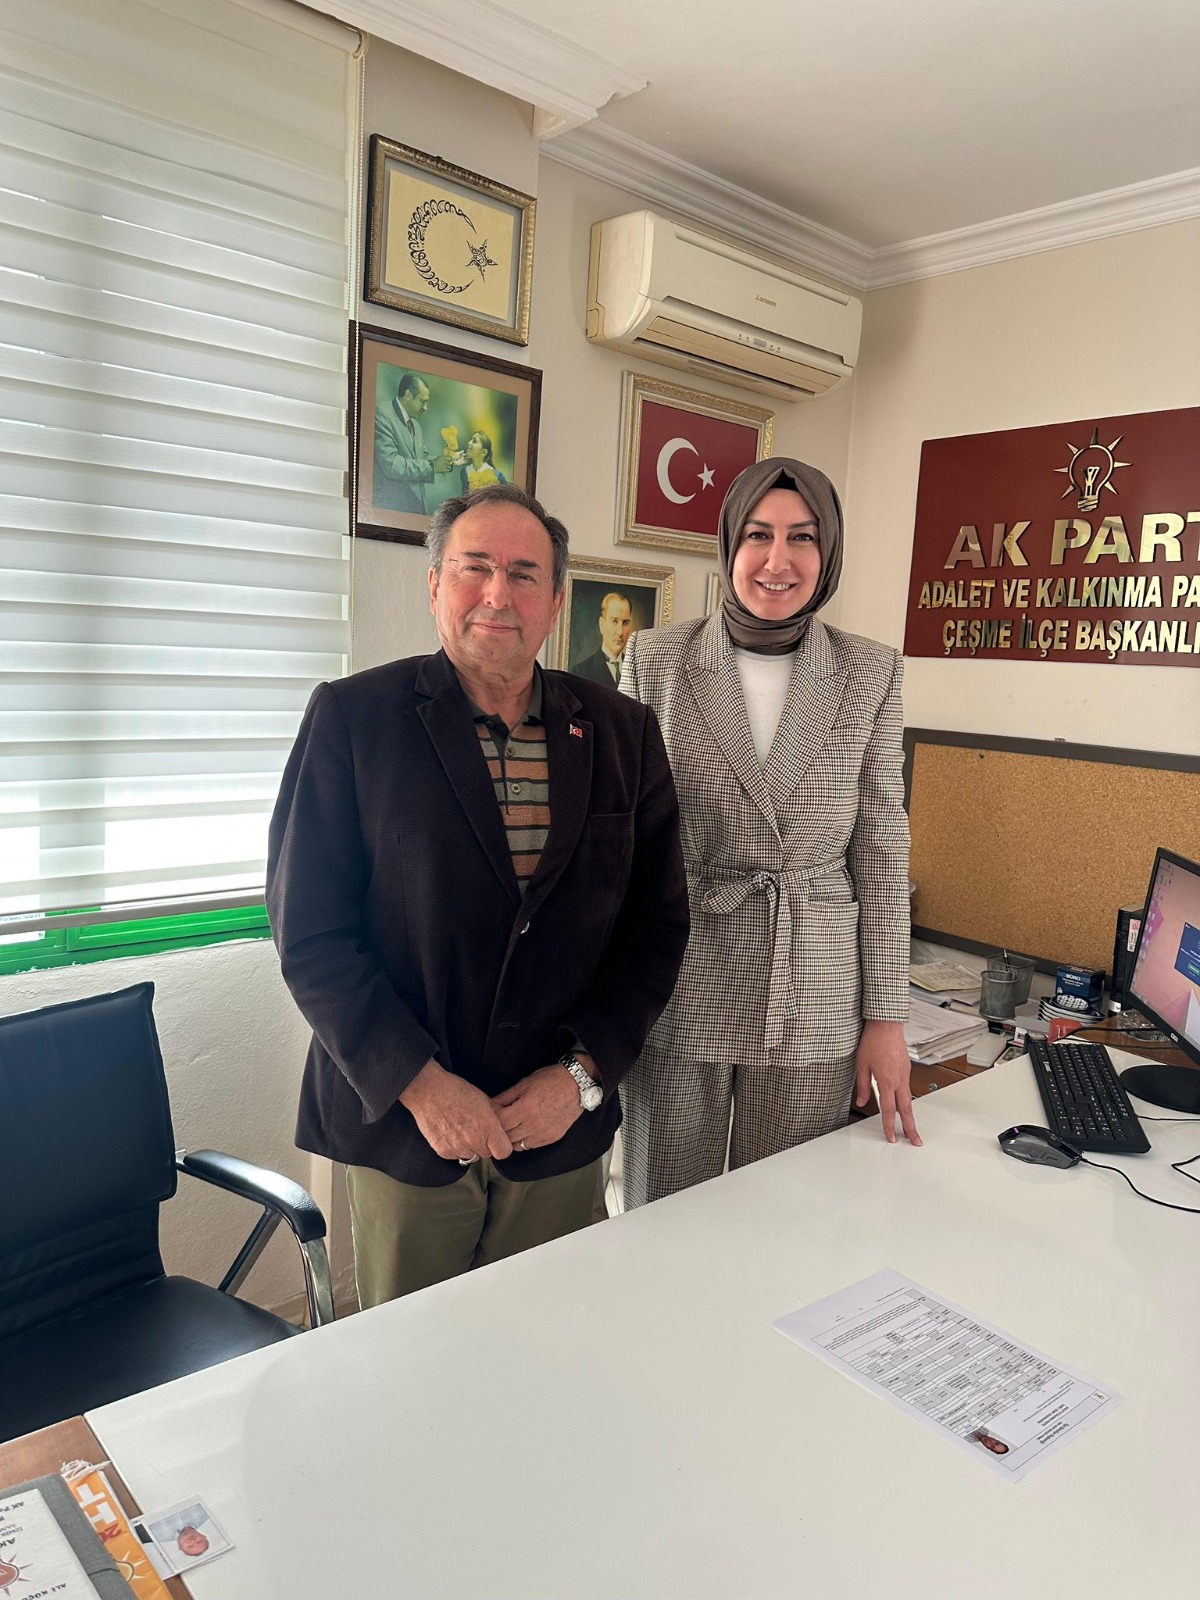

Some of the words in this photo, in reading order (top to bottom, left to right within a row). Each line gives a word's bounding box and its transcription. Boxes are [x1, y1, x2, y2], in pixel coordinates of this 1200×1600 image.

[943, 521, 1032, 569] AK
[917, 580, 996, 609] ADALET
[1002, 578, 1031, 608] VE
[1036, 575, 1162, 608] KALKINMA
[942, 619, 1013, 655] ÇEŞME
[1018, 613, 1070, 658] İLÇE
